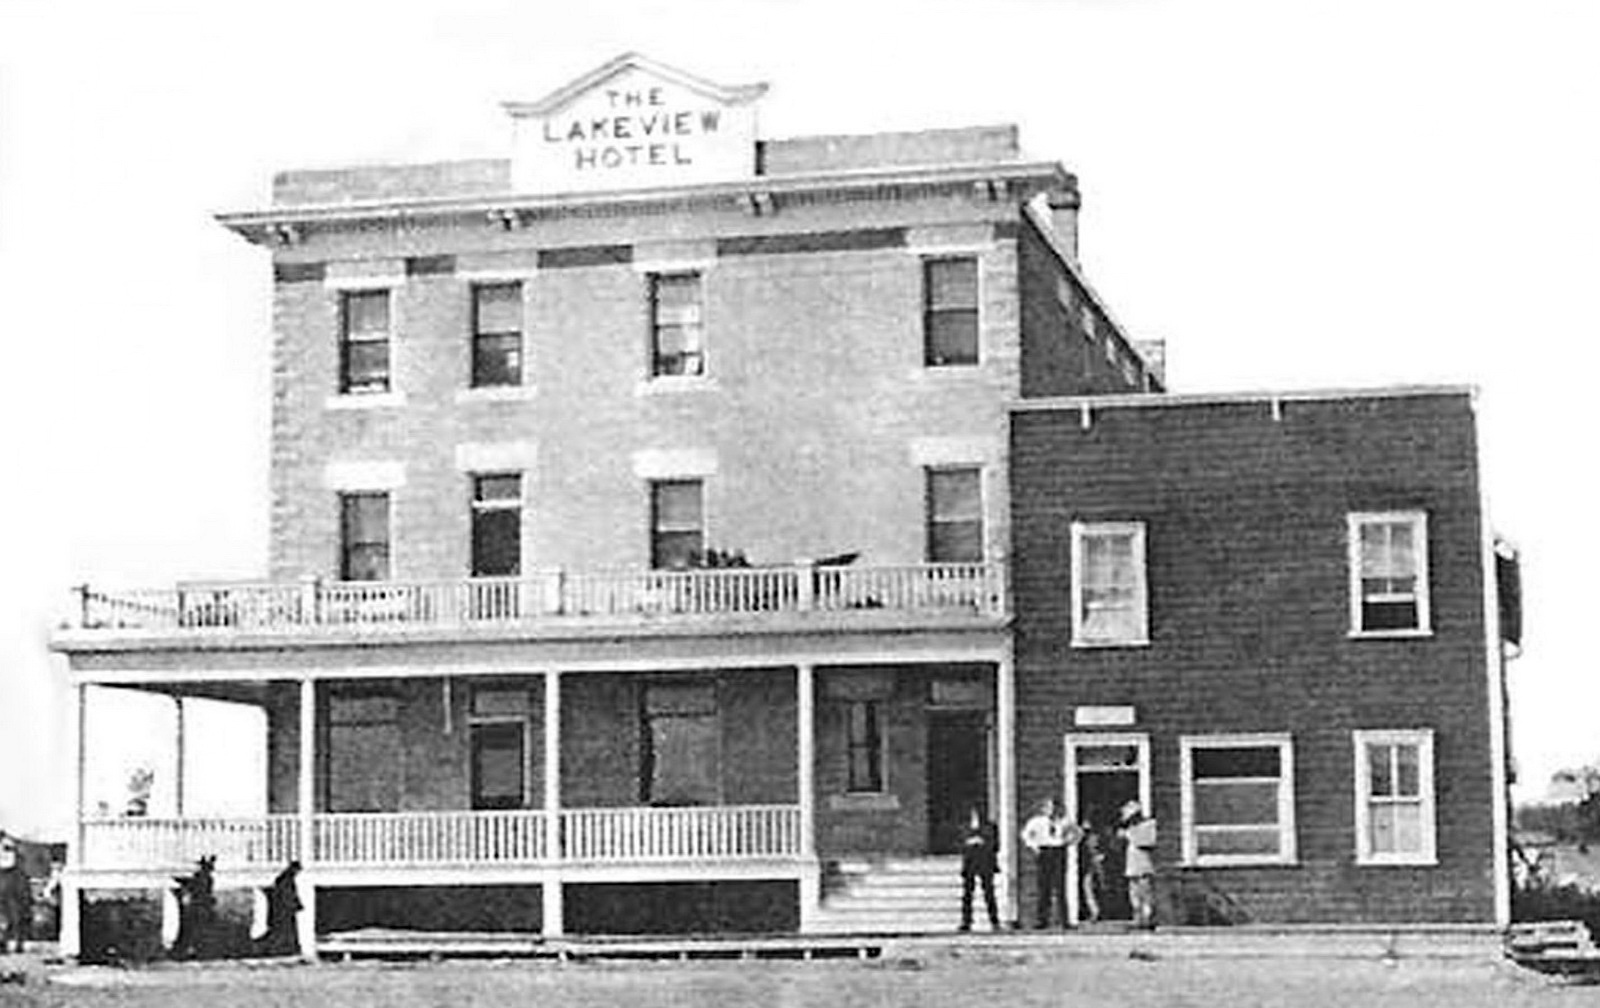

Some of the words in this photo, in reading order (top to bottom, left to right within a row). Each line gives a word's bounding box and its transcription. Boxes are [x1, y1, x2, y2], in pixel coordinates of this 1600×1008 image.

[606, 87, 665, 108] THE
[543, 111, 721, 142] LAKEVIEW
[575, 142, 692, 170] HOTEL
